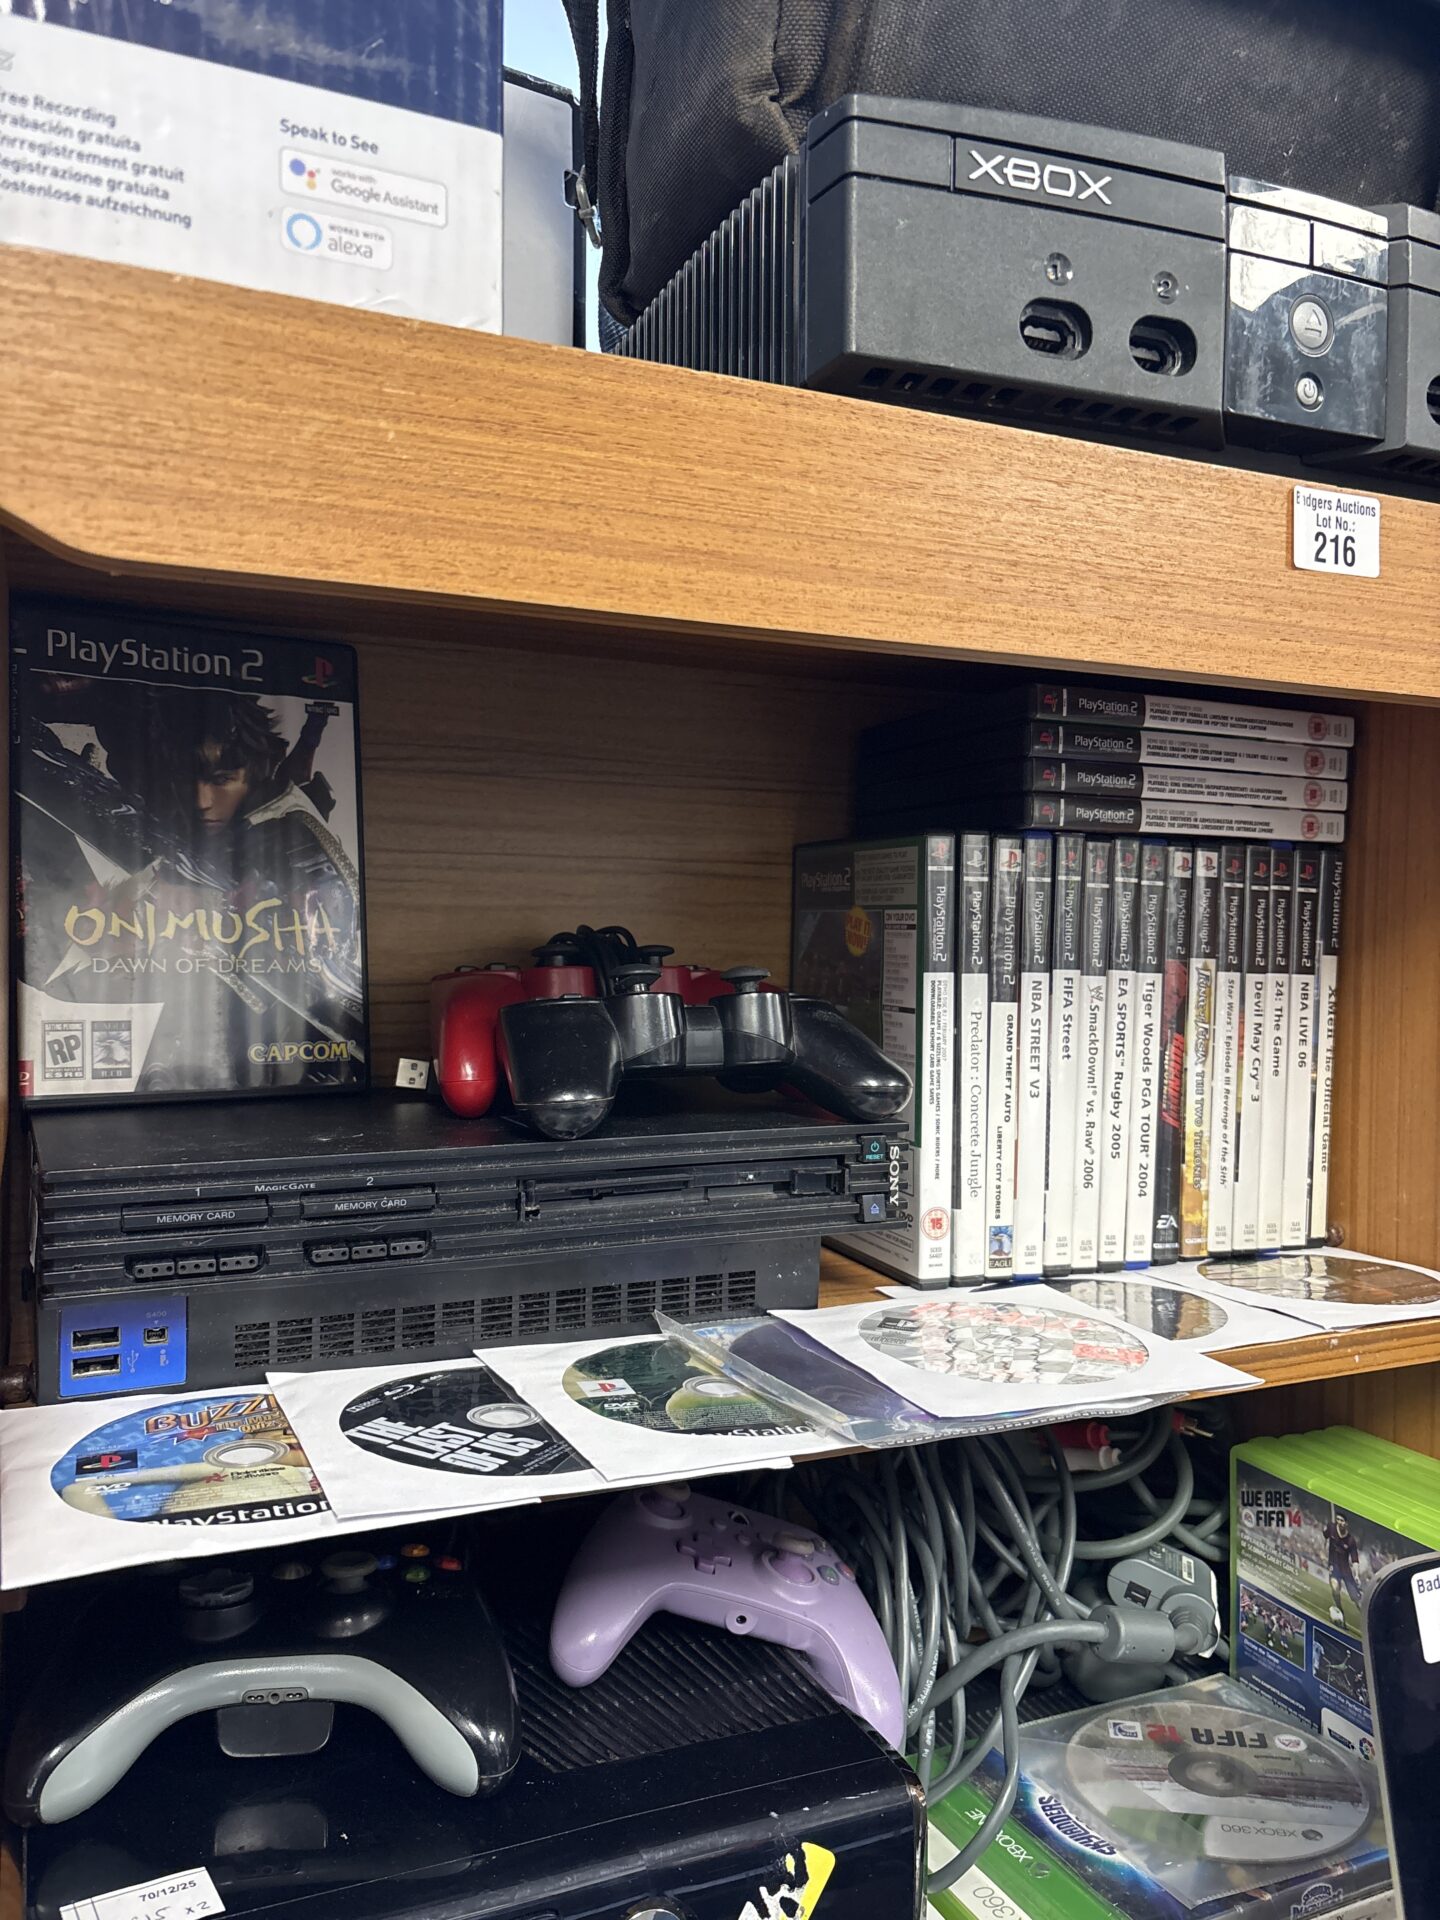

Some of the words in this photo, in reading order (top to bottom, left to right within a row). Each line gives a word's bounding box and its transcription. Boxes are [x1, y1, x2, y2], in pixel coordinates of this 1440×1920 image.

[0, 91, 29, 107] ree
[33, 95, 117, 129] Recording
[0, 112, 74, 139] rabación
[77, 128, 141, 153] gratuita
[279, 118, 329, 144] Speak
[332, 131, 347, 147] to
[351, 135, 379, 155] See
[0, 157, 104, 188] egistrazione
[106, 177, 170, 202] gratuita
[131, 160, 185, 184] gratuit
[968, 149, 1112, 206] XBOX
[0, 177, 82, 205] ostenlose
[85, 194, 192, 230] aufzeichnung
[331, 178, 381, 204] Google
[383, 192, 439, 216] Assistant
[327, 236, 374, 259] alexa
[329, 223, 360, 237] WORKS
[362, 230, 386, 242] WITH
[1157, 280, 1172, 299] 2
[1316, 513, 1332, 529] Lot
[1335, 516, 1356, 532] No.:
[1335, 498, 1376, 517] Auctions
[1314, 531, 1356, 567] 216
[47, 629, 231, 677] PlayStation
[241, 649, 263, 682] 2
[1078, 697, 1128, 715] PlayStation
[1130, 701, 1138, 713] 2
[1074, 734, 1124, 752] PlayStation
[1126, 739, 1133, 749] 2
[1077, 772, 1127, 789] PlayStation
[1128, 774, 1136, 785] 2
[1076, 807, 1126, 823] PlayStation
[1127, 808, 1134, 820] 2
[1332, 861, 1343, 934] PlayStation
[64, 897, 341, 960] ONIMUSHA
[933, 886, 946, 950] PlayStation
[970, 891, 982, 952] PlayStation
[1032, 891, 1044, 953] PlayStation
[1063, 890, 1074, 950] PlayStation
[1091, 896, 1103, 955] PlayStation
[1120, 891, 1131, 950] PlayStation
[1145, 894, 1157, 953] PlayStation
[1176, 889, 1187, 943] PlayStation
[1201, 888, 1211, 943] PlayStation
[1228, 896, 1239, 953] PlayStation
[1255, 899, 1265, 955] PlayStation
[1275, 898, 1286, 955] PlayStation
[1301, 901, 1312, 956] PlayStation
[1002, 896, 1016, 970] PlayStation
[92, 957, 167, 974] DAWN
[175, 958, 208, 974] OF
[218, 957, 323, 974] DREAMS
[936, 953, 947, 962] 2
[972, 956, 983, 965] 2
[1034, 955, 1044, 964] 2
[1064, 953, 1074, 961] 2
[1092, 959, 1102, 968] 2
[1120, 953, 1130, 962] 2
[1147, 956, 1157, 965] 2
[1228, 956, 1238, 964] 2
[1256, 958, 1265, 966] 2
[1276, 958, 1286, 966] 2
[1003, 975, 1016, 985] 2
[1063, 977, 1073, 1008] FIFA
[1118, 978, 1128, 998] EA
[1275, 981, 1284, 1001] 24:
[1031, 980, 1042, 1013] NBA
[1142, 980, 1155, 1017] Tiger
[1254, 981, 1264, 1017] Devil
[1300, 982, 1310, 1011] NBA
[1006, 1014, 1014, 1052] GRAND
[1274, 1008, 1283, 1031] The
[1299, 1017, 1308, 1046] LIVE
[47, 1034, 81, 1066] RP
[970, 1011, 983, 1073] Predator
[1030, 1018, 1041, 1072] STREET
[1062, 1014, 1072, 1060] Street
[1142, 1022, 1154, 1073] Woods
[1250, 1022, 1262, 1053] May
[248, 1040, 351, 1065] CAPCOM
[1224, 1035, 1232, 1074] Episode
[1272, 1036, 1282, 1077] Game
[1298, 1052, 1307, 1068] 06
[1325, 1047, 1333, 1072] The
[1005, 1055, 1013, 1090] THEFT
[1194, 1070, 1205, 1095] THE
[1030, 1079, 1040, 1098] V3
[1110, 1071, 1123, 1119] Rugby
[1141, 1079, 1151, 1109] PGA
[1251, 1094, 1259, 1102] 3
[1323, 1077, 1332, 1128] Official
[970, 1084, 982, 1146] Concrete
[1003, 1093, 1012, 1123] AUTO
[1086, 1100, 1095, 1117] vs.
[1194, 1099, 1205, 1127] TWO
[1221, 1088, 1231, 1130] Revenge
[1110, 1128, 1121, 1159] 2005
[1221, 1132, 1229, 1144] of
[1321, 1133, 1330, 1172] Game
[967, 1150, 982, 1198] Jungle
[1083, 1159, 1094, 1189] 2006
[1193, 1131, 1204, 1190] THRONES
[366, 1176, 374, 1186] 2
[889, 1145, 900, 1207] SONY
[1138, 1163, 1148, 1197] 2004
[156, 1212, 202, 1223] MEMORY
[206, 1211, 235, 1220] CARD
[335, 1200, 377, 1211] MEMORY
[381, 1199, 407, 1208] CARD
[930, 1217, 943, 1230] 15
[1156, 1215, 1178, 1229] EA
[145, 1311, 167, 1319] S400
[145, 1394, 275, 1435] BUZZ!
[344, 1417, 424, 1445] THE
[387, 1422, 487, 1460] LAST
[467, 1431, 546, 1457] US
[439, 1447, 509, 1473] OF
[84, 1482, 131, 1492] DVD
[1240, 1490, 1263, 1507] WE
[1265, 1490, 1291, 1507] ARE
[1256, 1510, 1285, 1527] FIFA
[1285, 1510, 1302, 1527] 14
[1146, 1724, 1183, 1745] 12
[1191, 1727, 1268, 1749] FIFA
[1038, 1795, 1117, 1856] SKYLANDERS
[1221, 1823, 1250, 1834] 360
[1254, 1825, 1298, 1838] XBOX
[995, 1830, 1033, 1863] XBOX
[973, 1887, 1015, 1919] 360
